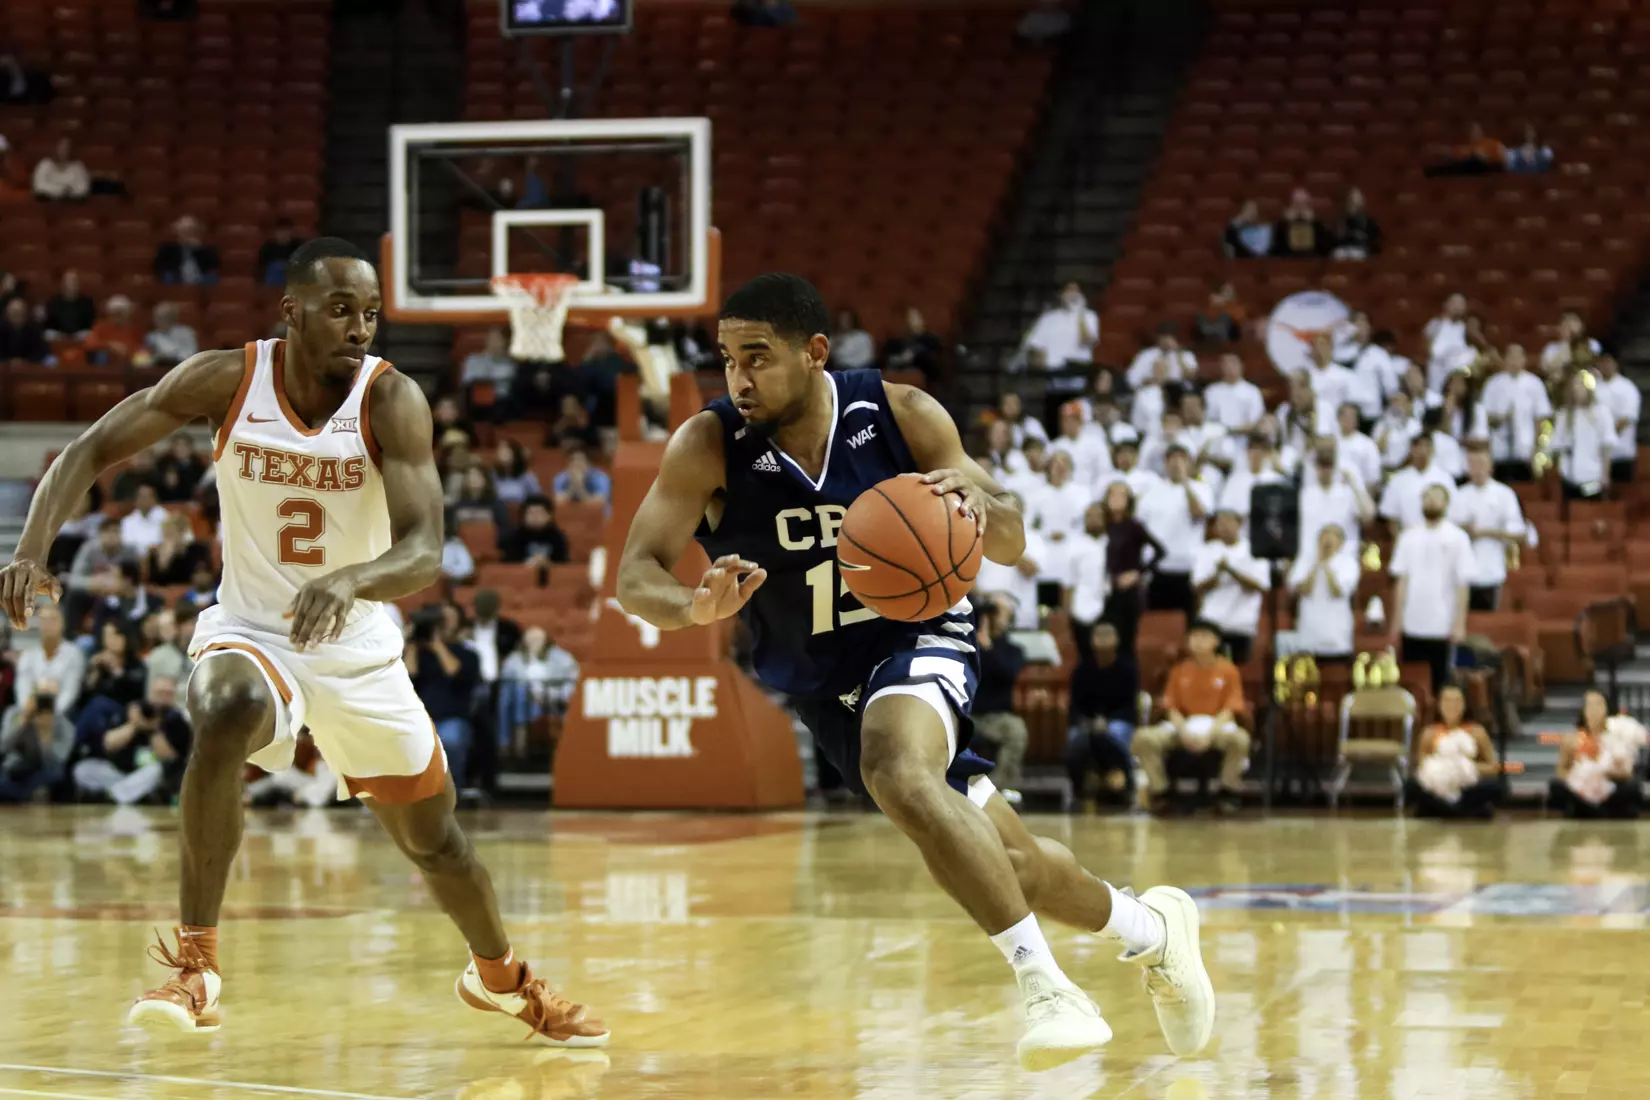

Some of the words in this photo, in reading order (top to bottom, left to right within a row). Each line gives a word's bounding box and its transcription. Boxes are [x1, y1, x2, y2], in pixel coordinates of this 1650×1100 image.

[846, 424, 877, 449] WAC
[234, 442, 366, 491] TEXAS
[752, 462, 781, 473] adidas
[277, 497, 325, 567] 2
[775, 504, 849, 550] CB
[583, 676, 718, 719] MUSCLE
[608, 717, 694, 758] MILK
